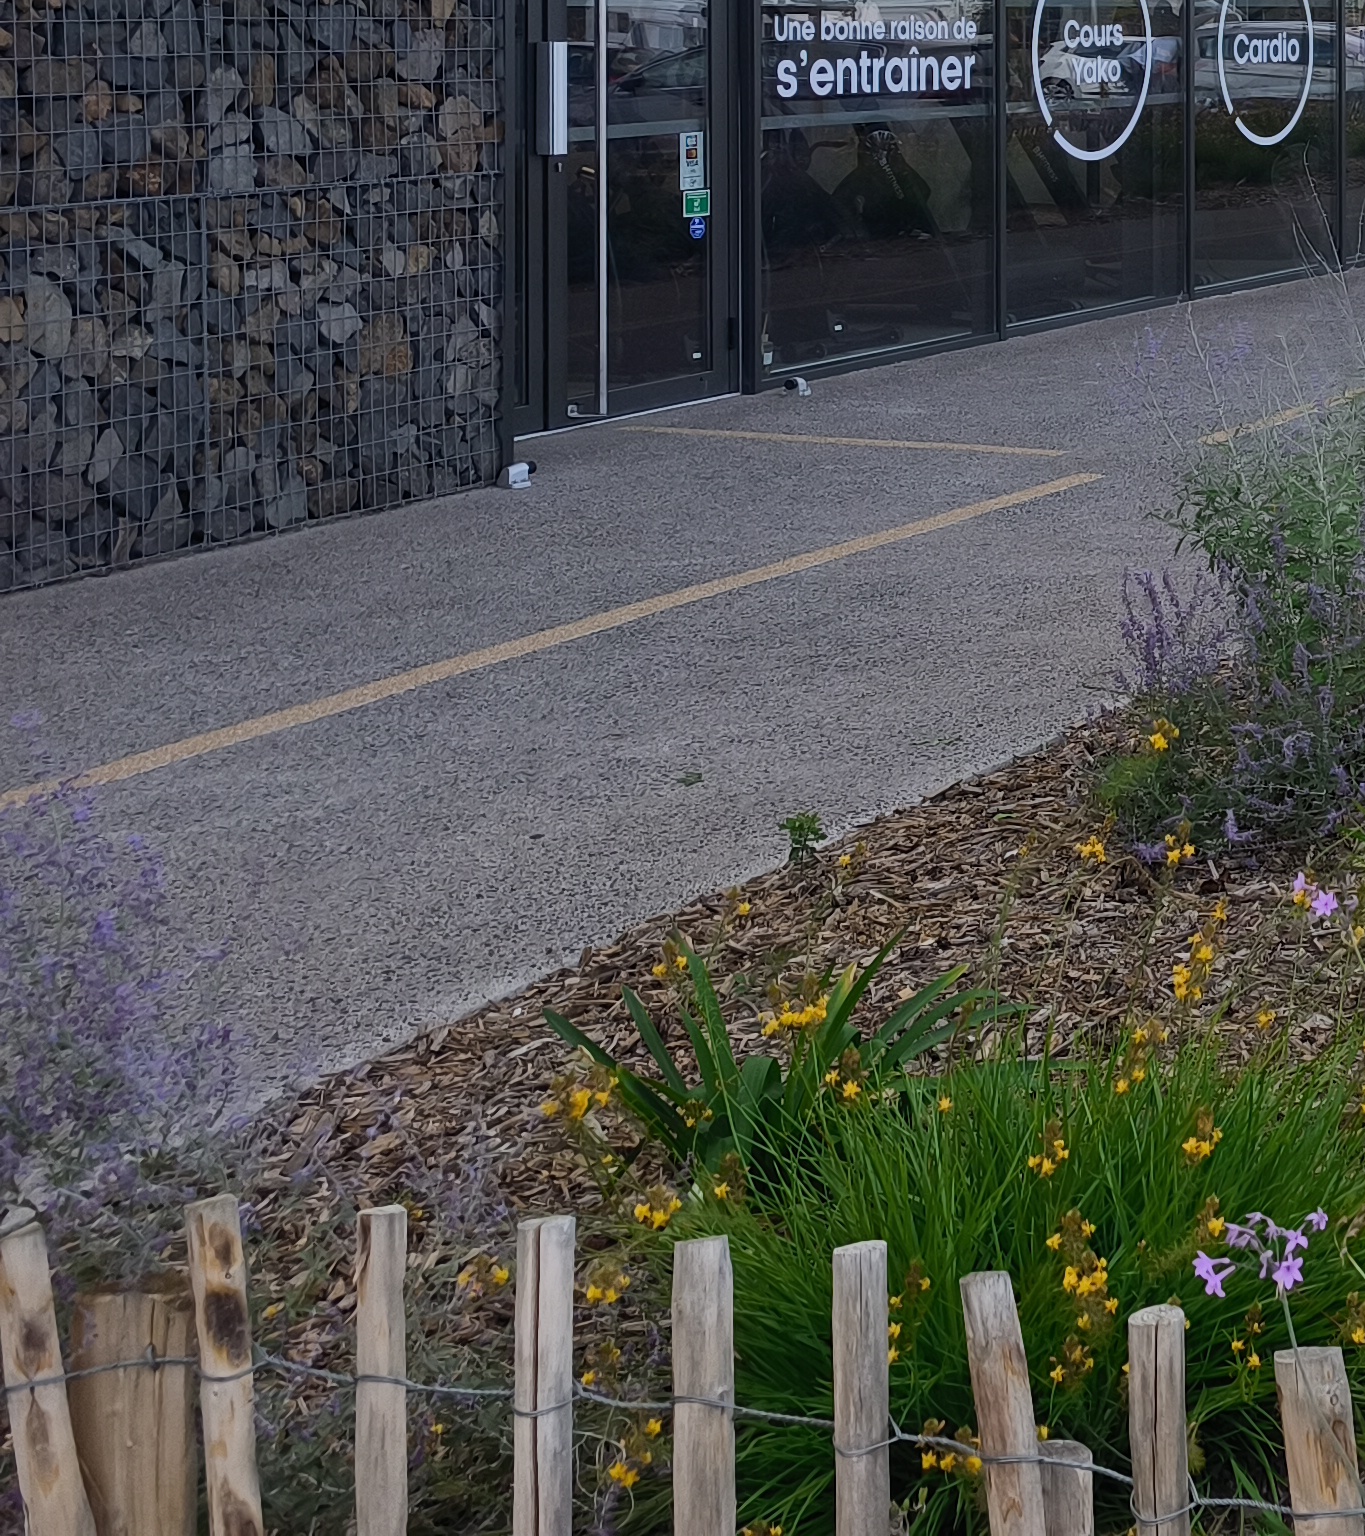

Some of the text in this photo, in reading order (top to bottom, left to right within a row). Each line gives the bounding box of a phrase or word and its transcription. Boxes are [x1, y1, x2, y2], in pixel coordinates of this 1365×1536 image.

[774, 14, 976, 41] Une bonne raison de
[1064, 19, 1123, 48] Cours
[1233, 31, 1300, 64] Cardio
[776, 45, 975, 98] s'entraîner
[1072, 55, 1121, 85] Yako
